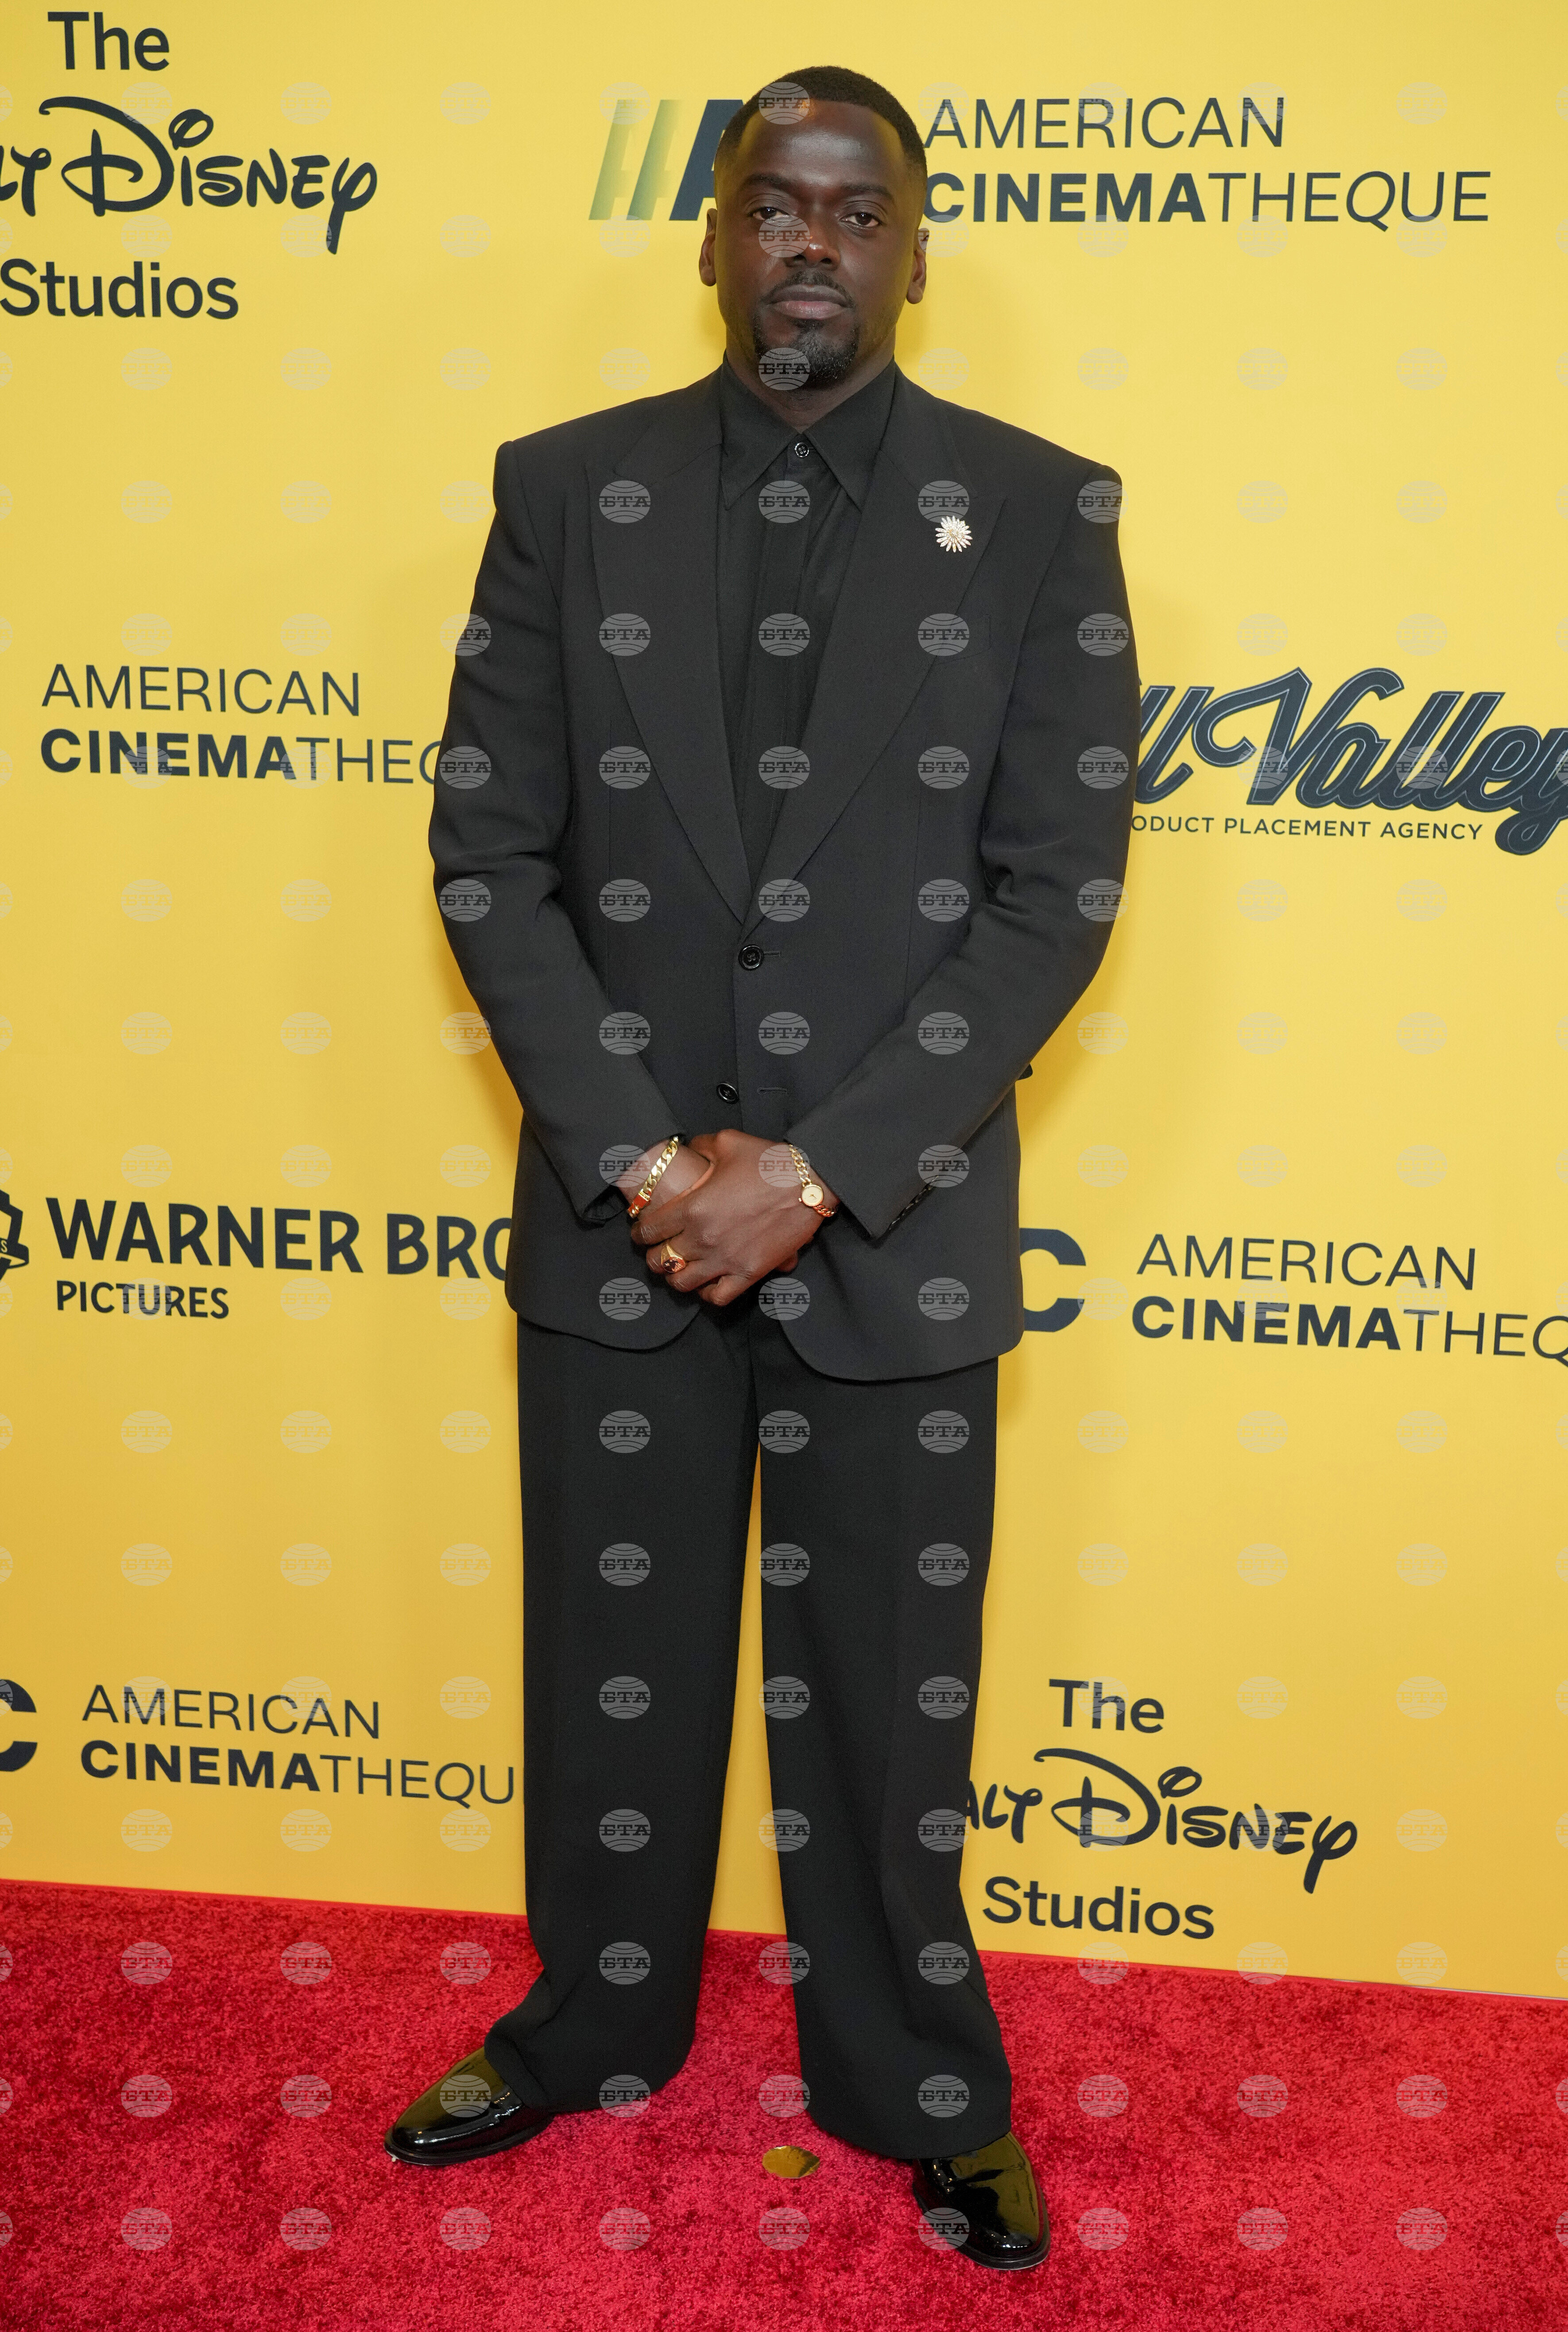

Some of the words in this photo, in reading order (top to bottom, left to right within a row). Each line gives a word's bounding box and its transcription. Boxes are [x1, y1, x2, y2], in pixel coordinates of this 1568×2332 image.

[47, 12, 170, 71] The
[924, 97, 1284, 149] AMERICAN
[923, 171, 1491, 232] CINEMATHEQUE
[0, 258, 239, 320] Studios
[42, 664, 359, 717] AMERICAN
[1225, 818, 1371, 837] PLACEMENT
[1380, 822, 1483, 840] AGENCY
[45, 1197, 364, 1273] WARNER
[1137, 1234, 1475, 1290] AMERICAN
[56, 1280, 229, 1319] PICTURES
[82, 1685, 379, 1739] AMERICAN
[1049, 1678, 1164, 1733] The
[983, 1876, 1214, 1940] Studios
